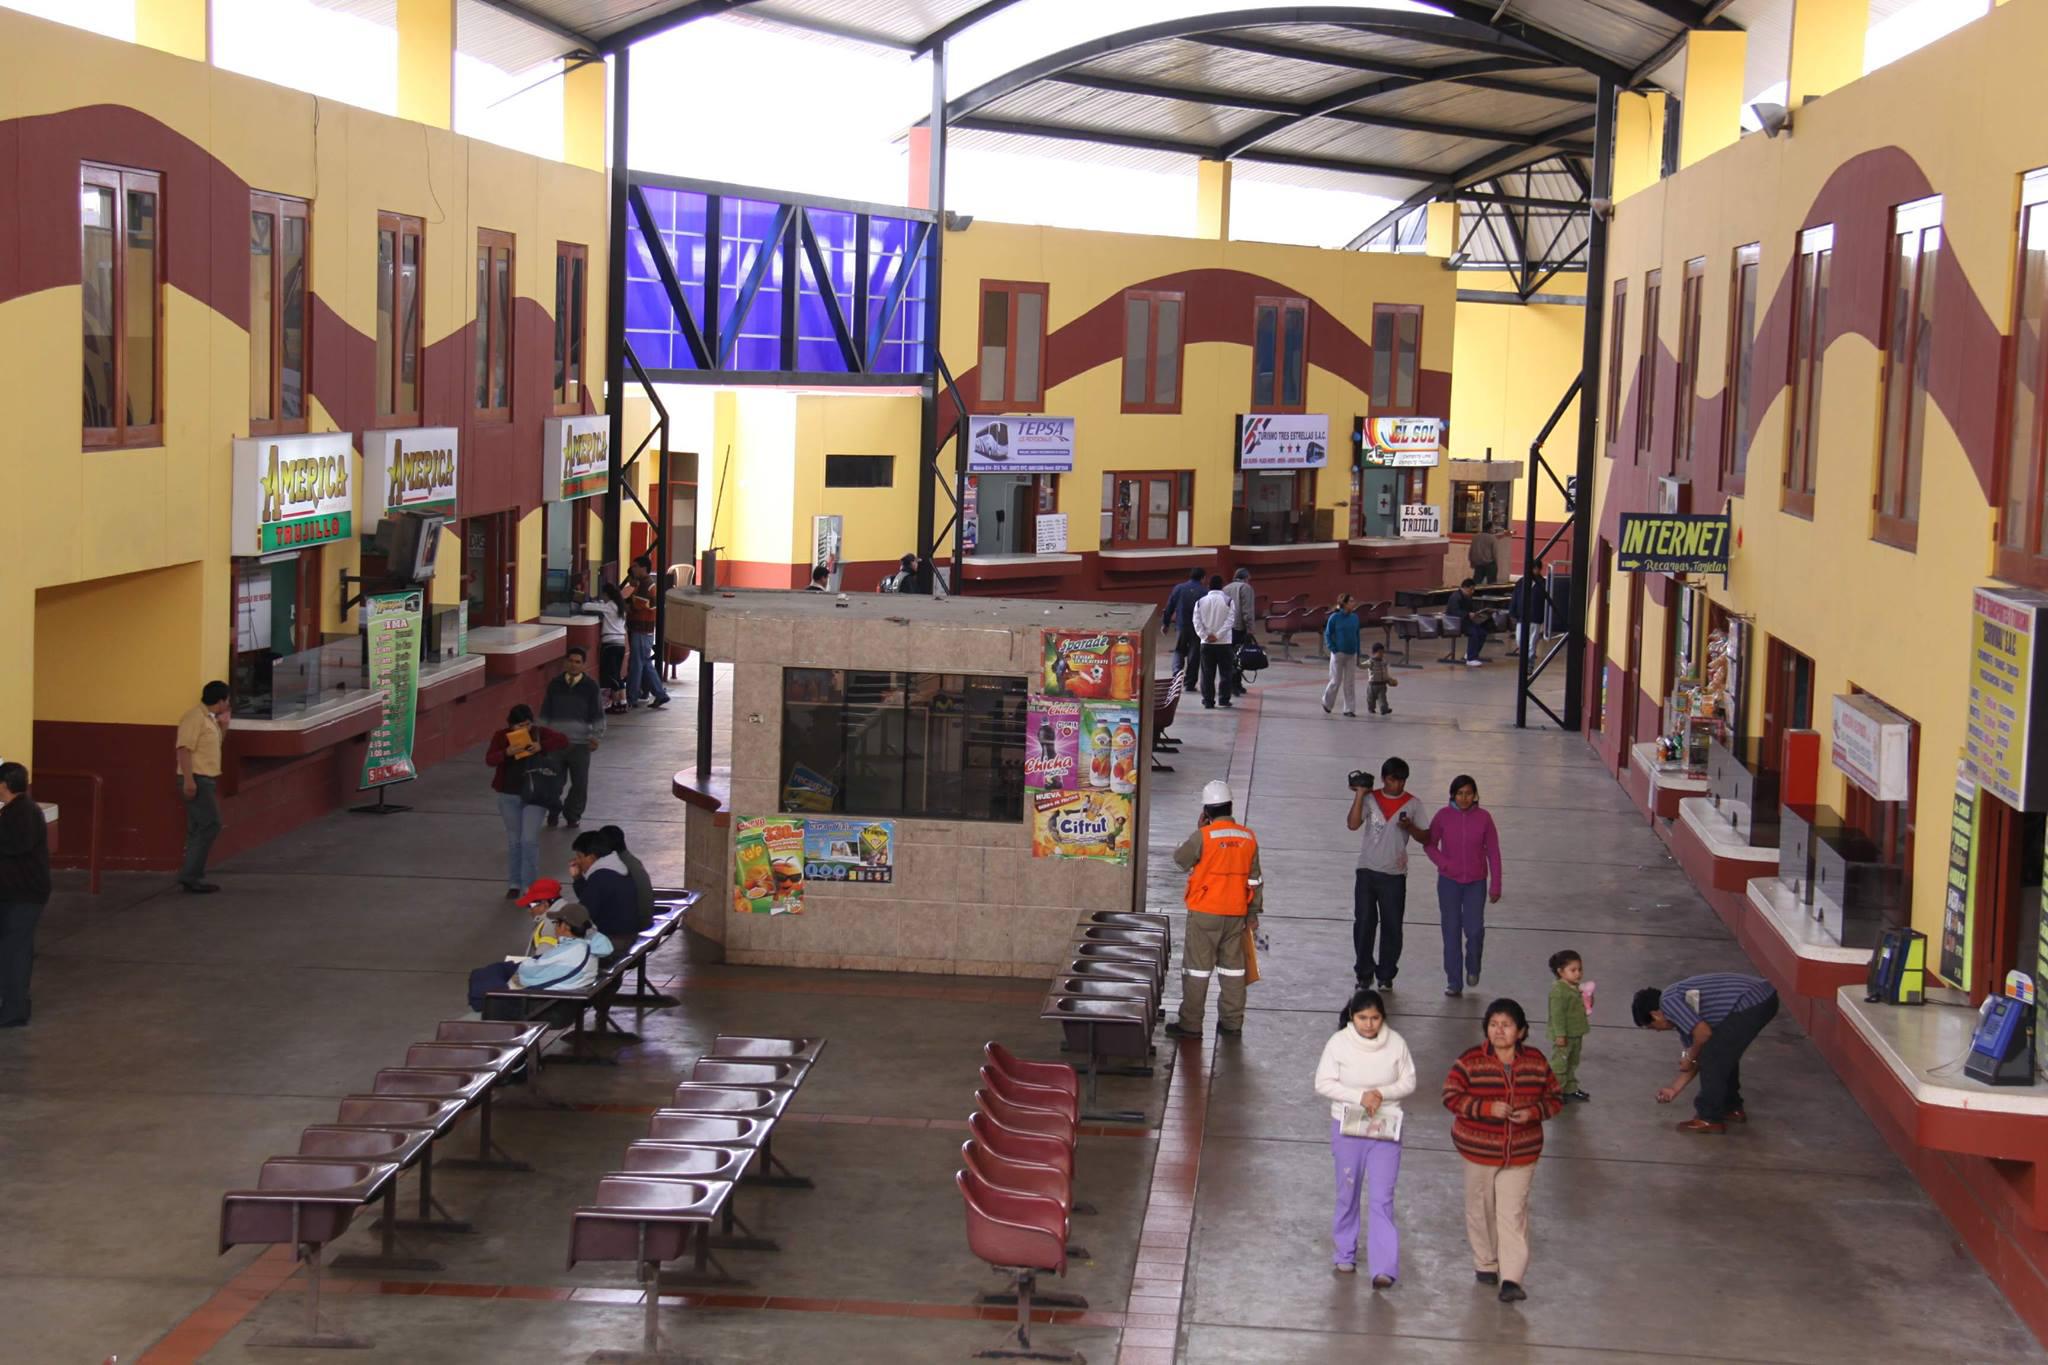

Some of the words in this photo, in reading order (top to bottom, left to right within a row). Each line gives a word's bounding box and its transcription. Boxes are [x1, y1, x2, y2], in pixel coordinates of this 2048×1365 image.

[1017, 421, 1064, 435] TEPSA
[1257, 431, 1278, 441] TURISMO
[1278, 431, 1290, 441] TRES
[1290, 431, 1314, 441] ESTRELLAS
[1411, 424, 1436, 443] SOL
[387, 438, 455, 506] AMERICA
[260, 444, 348, 522] AMERICA
[1405, 506, 1416, 516] EL
[1418, 506, 1433, 516] SOL
[275, 517, 341, 546] TRUJILLO
[1402, 518, 1439, 533] TRUJILLO
[1621, 519, 1728, 557] INTERNET
[1024, 754, 1073, 775] Chicha
[1036, 791, 1062, 801] NUEVA
[1060, 817, 1107, 835] Cifrut
